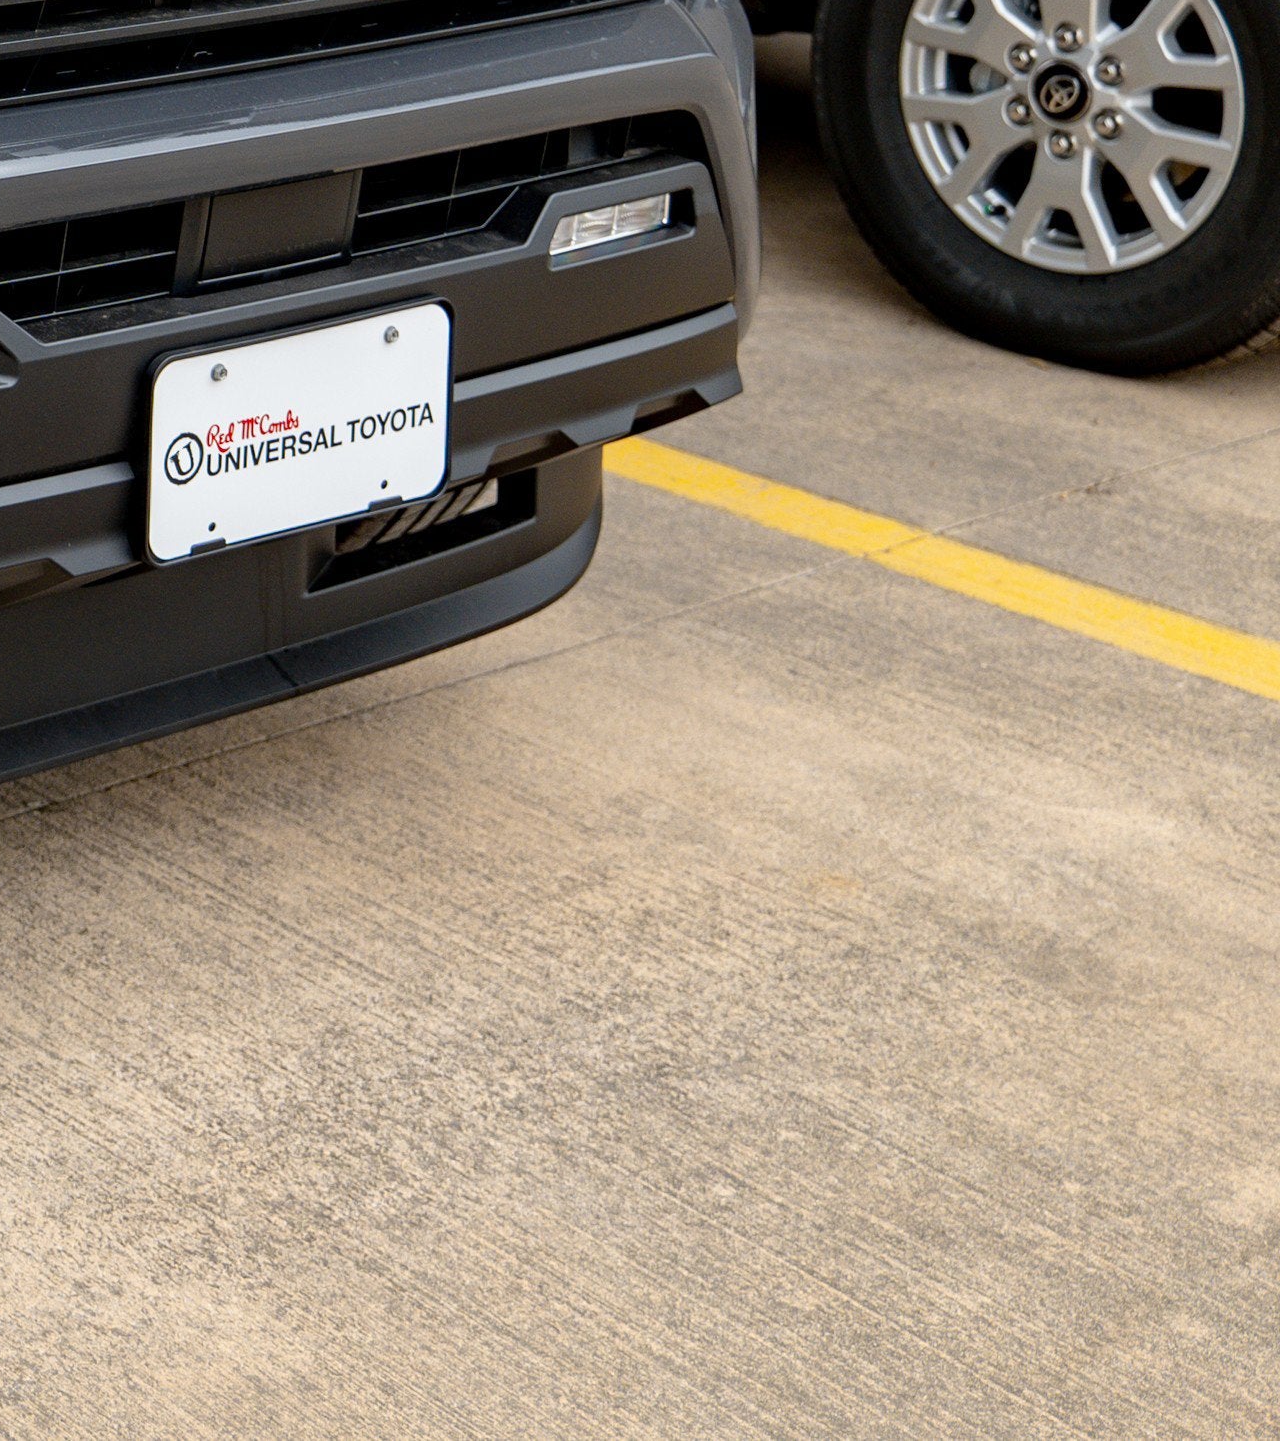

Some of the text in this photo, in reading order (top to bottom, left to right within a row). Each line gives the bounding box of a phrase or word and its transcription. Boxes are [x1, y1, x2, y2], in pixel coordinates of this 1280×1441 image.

[206, 410, 300, 452] Red McCombs
[206, 402, 434, 477] UNIVERSAL TOYOTA
